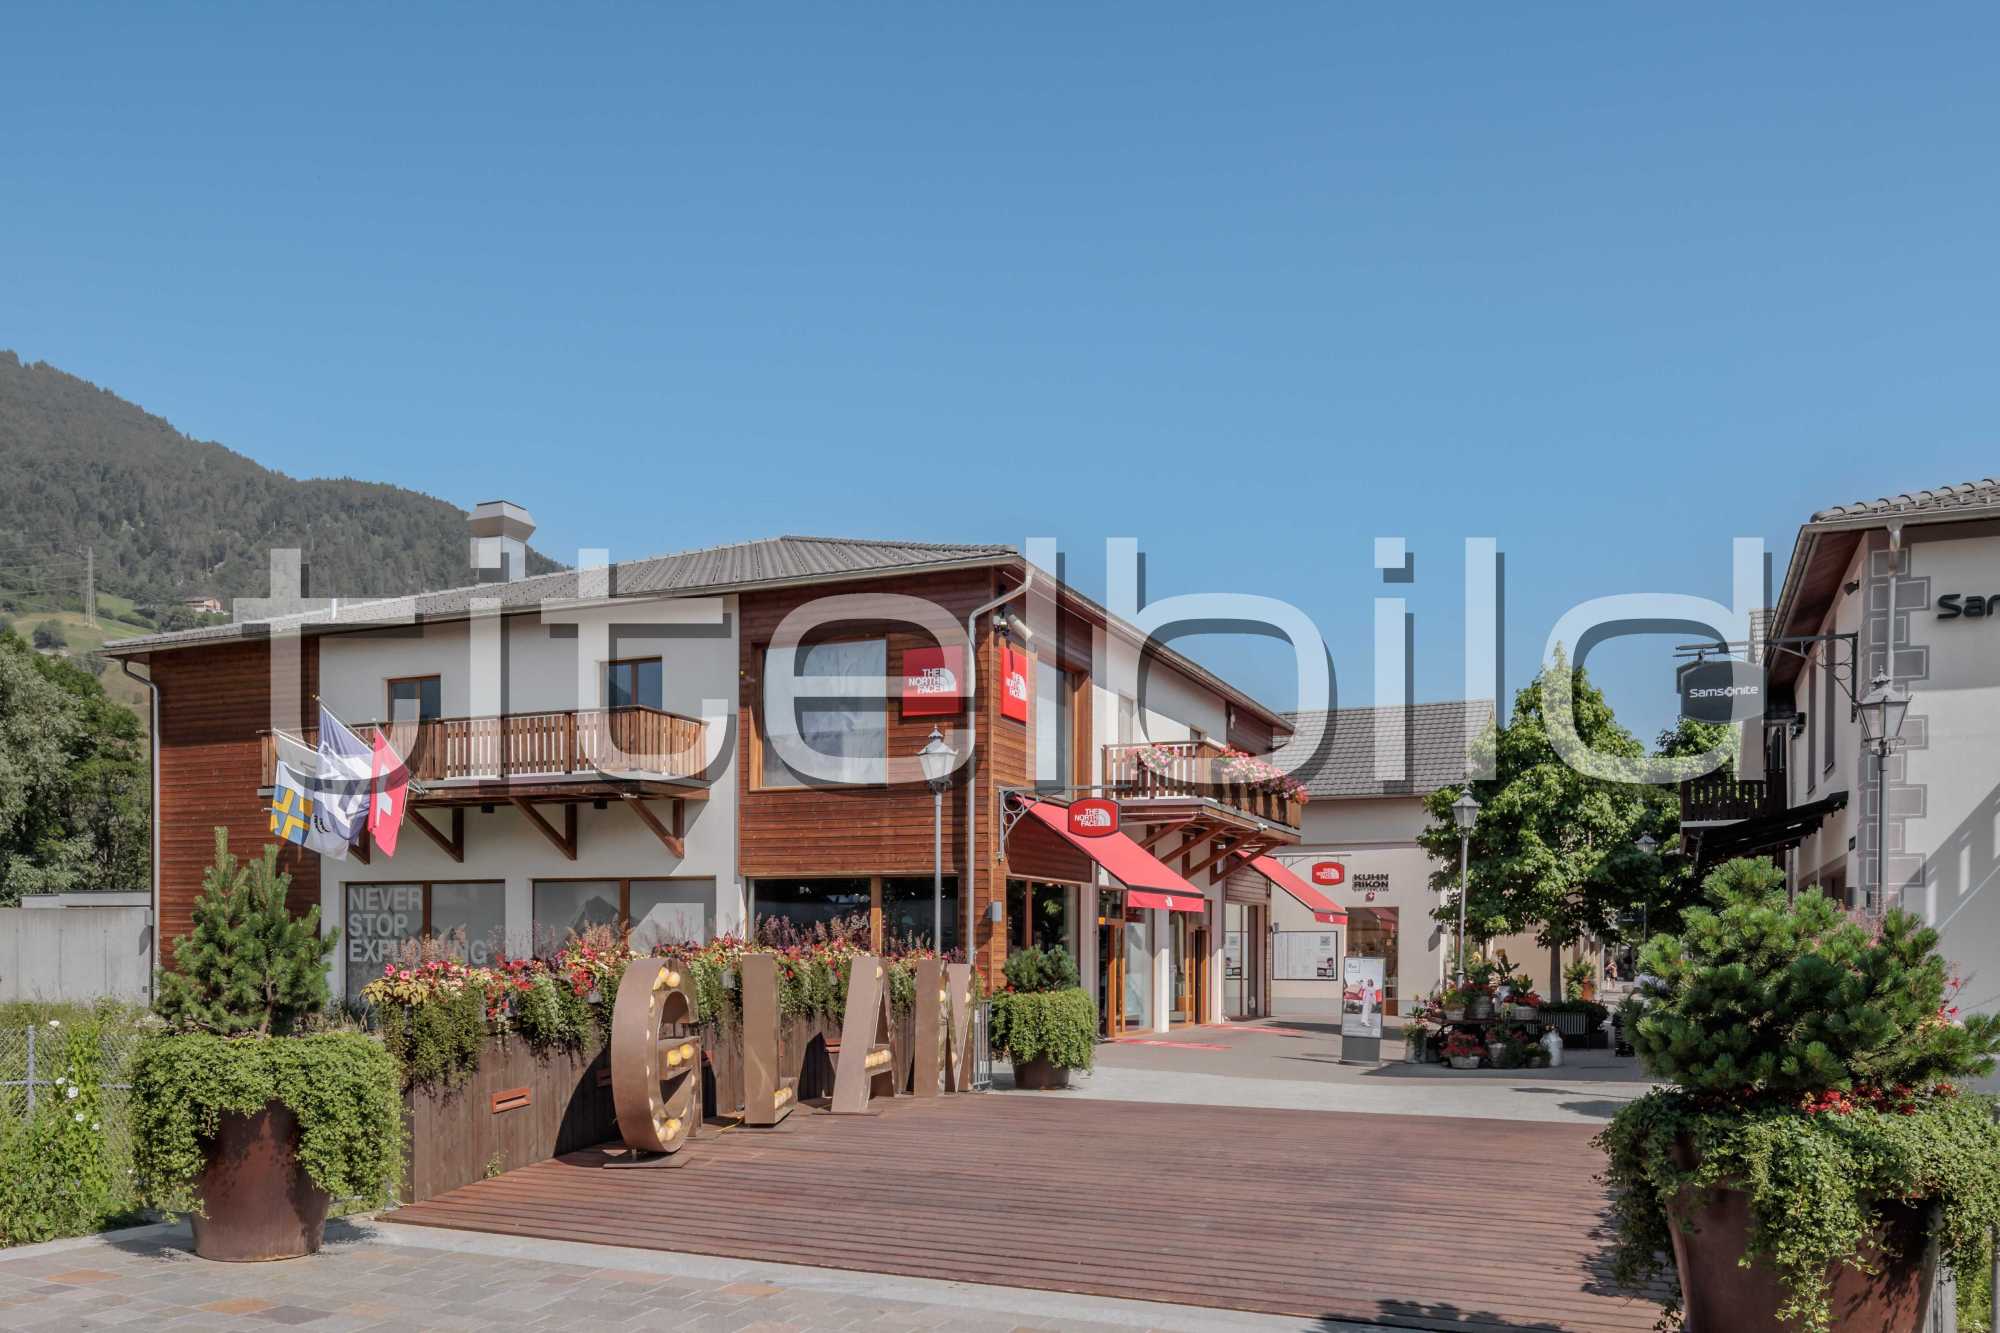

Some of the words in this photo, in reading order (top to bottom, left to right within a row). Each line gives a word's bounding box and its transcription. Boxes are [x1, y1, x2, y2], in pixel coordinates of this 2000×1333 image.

[922, 668, 941, 677] THE
[908, 677, 941, 687] NORTH
[917, 685, 941, 694] FACE
[1353, 873, 1389, 881] KUHN
[350, 887, 423, 911] NEVER
[348, 913, 408, 937] STOP
